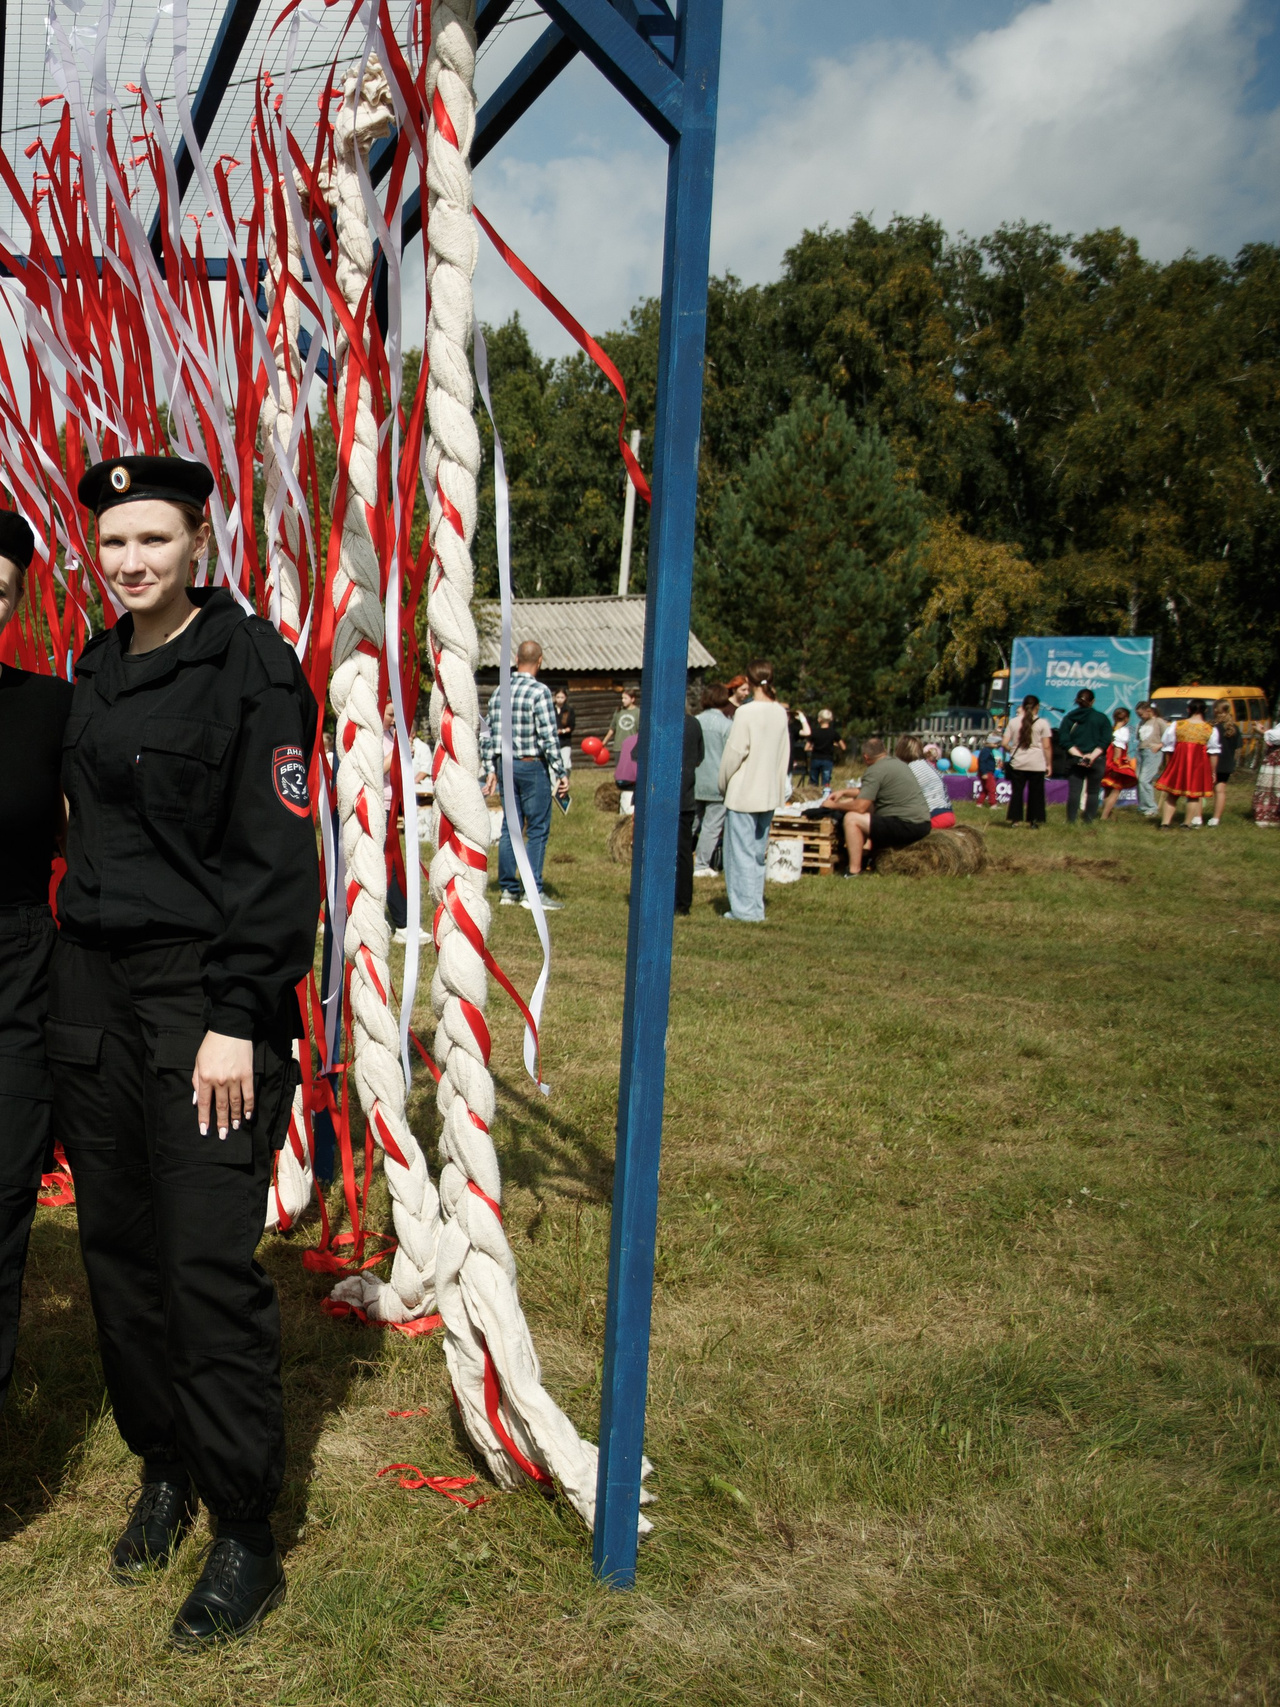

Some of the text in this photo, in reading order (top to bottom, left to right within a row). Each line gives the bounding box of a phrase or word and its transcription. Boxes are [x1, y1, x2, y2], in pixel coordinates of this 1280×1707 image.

[1046, 660, 1111, 679] ГОЛОС
[280, 763, 306, 775] БЕРКУ
[295, 773, 303, 785] 2
